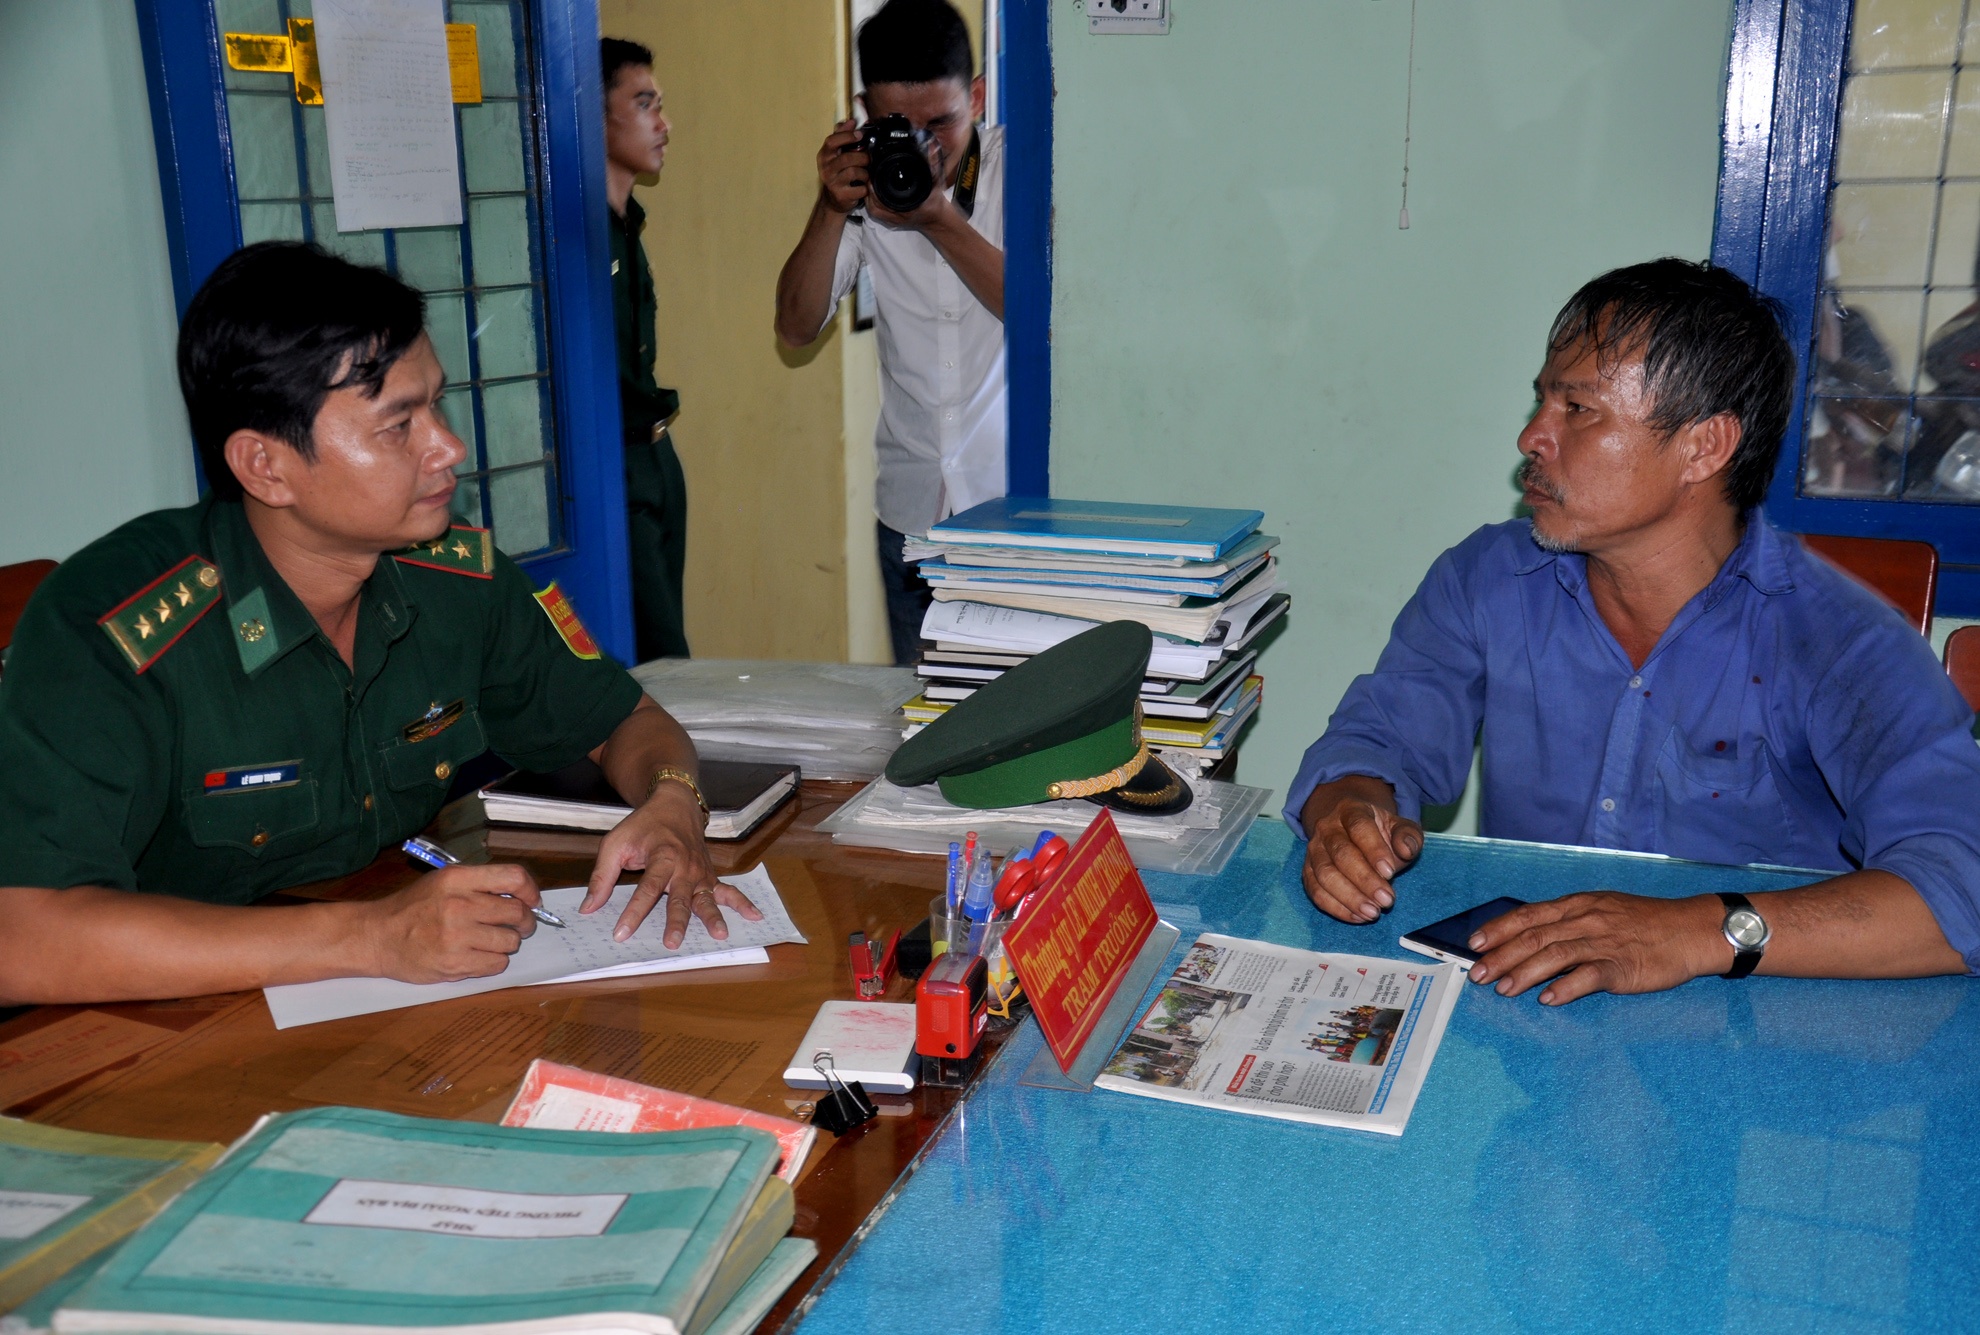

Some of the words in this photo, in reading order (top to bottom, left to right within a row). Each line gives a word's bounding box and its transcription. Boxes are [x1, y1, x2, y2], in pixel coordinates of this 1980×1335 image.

[961, 156, 976, 190] Nikon
[1092, 836, 1129, 897] TRỌNG
[1072, 866, 1106, 925] MINH
[1061, 884, 1087, 941] LÊ
[1020, 929, 1071, 999] Thượng
[1061, 960, 1100, 1023] TRẠM
[1093, 902, 1138, 973] TRƯỞNG
[1260, 1060, 1274, 1071] sao
[1253, 1069, 1269, 1078] thi
[1272, 1074, 1289, 1087] phù
[1244, 1085, 1261, 1094] Ra
[1266, 1085, 1283, 1096] cho
[355, 1197, 387, 1207] BÀN
[393, 1200, 418, 1210] ĐỊA
[420, 1203, 471, 1215] NGOÀI
[475, 1207, 511, 1218] TIỆN
[515, 1210, 582, 1219] PHƯƠNG
[431, 1220, 476, 1232] NHẬP
